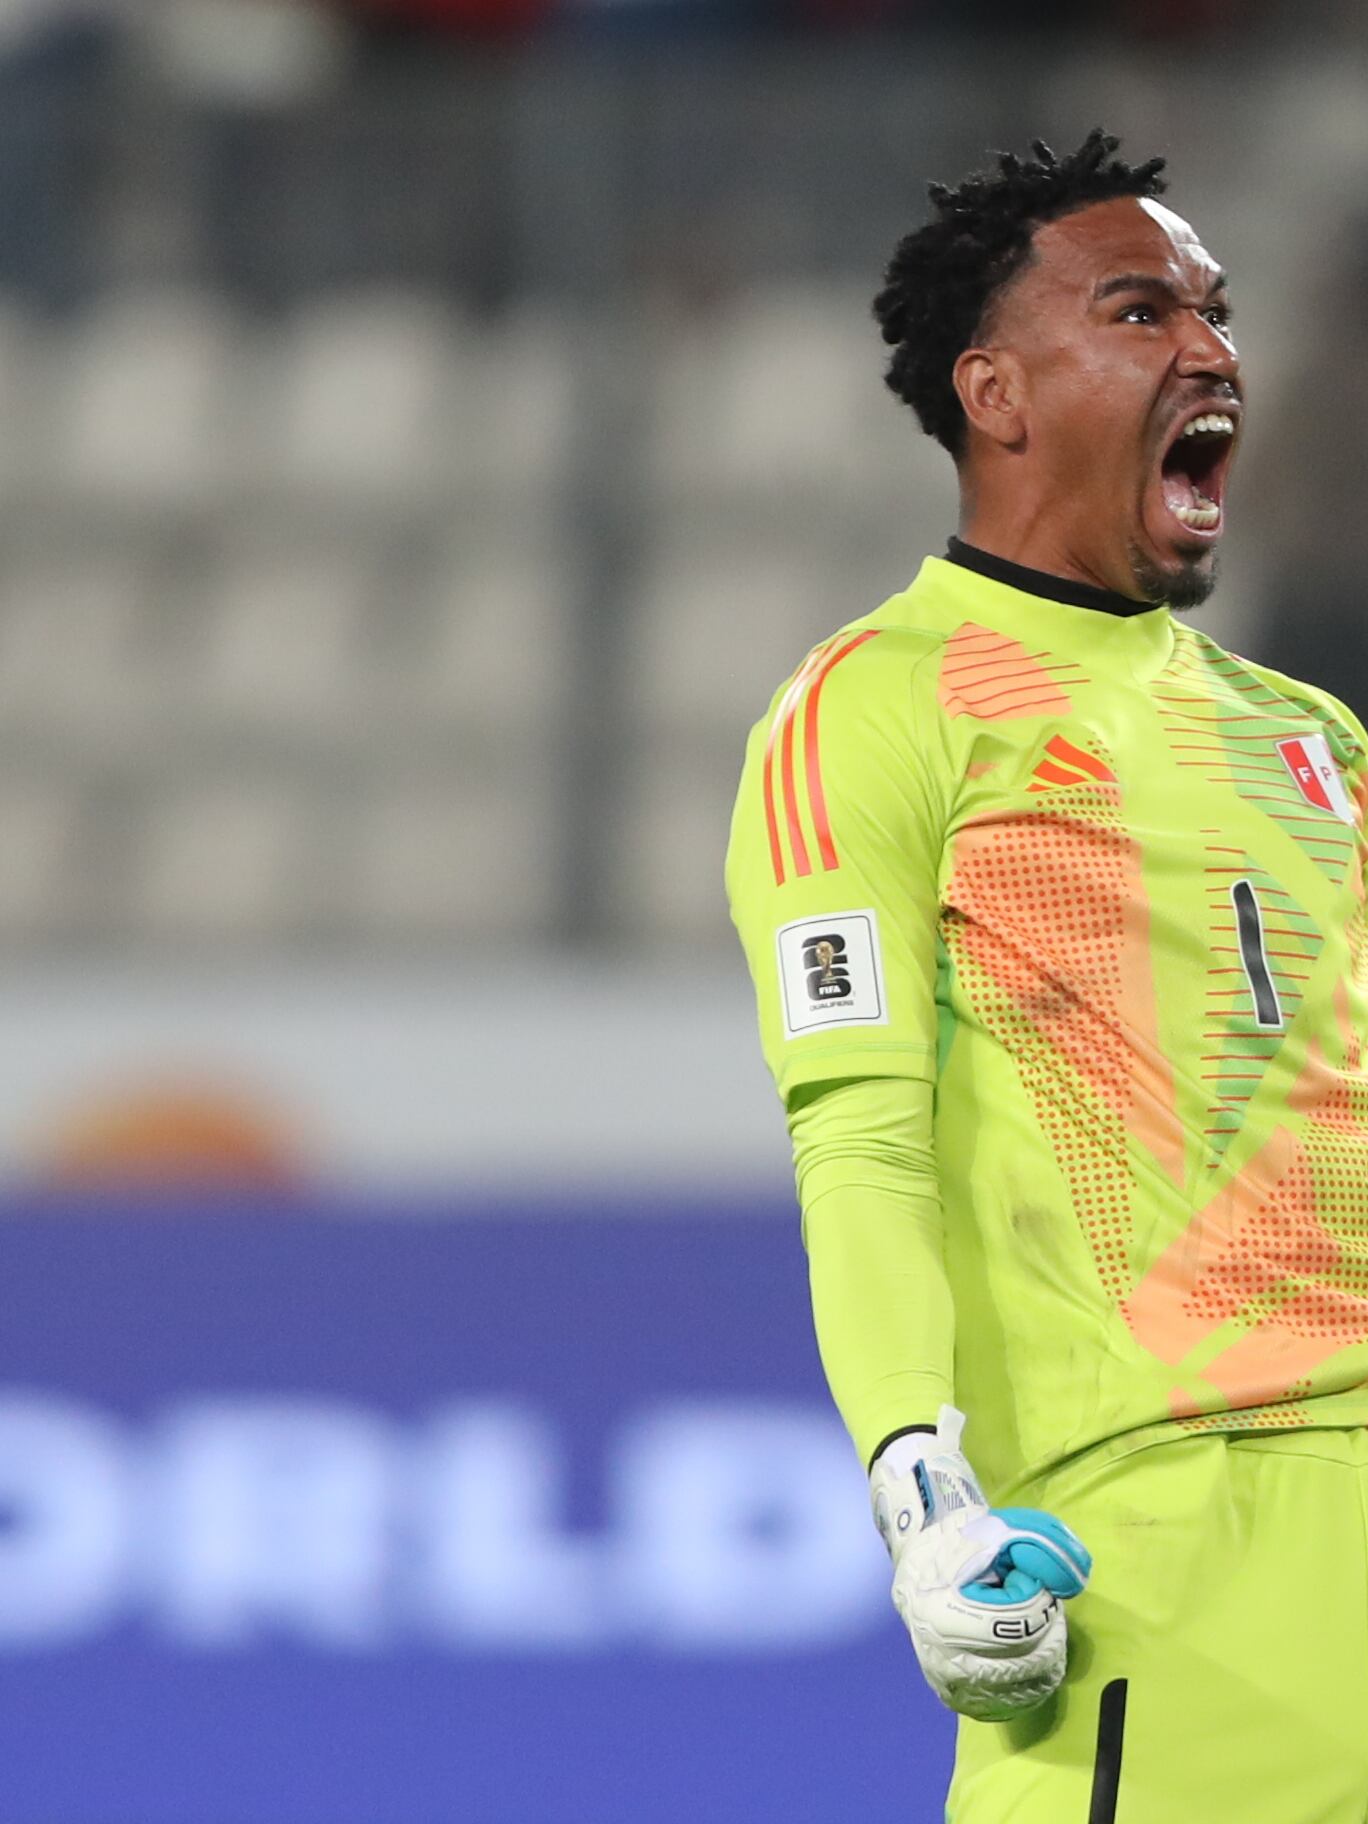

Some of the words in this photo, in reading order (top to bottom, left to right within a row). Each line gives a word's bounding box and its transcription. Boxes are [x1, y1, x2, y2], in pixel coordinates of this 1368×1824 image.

[1230, 879, 1283, 1029] 1
[818, 984, 842, 995] FIFA
[993, 1597, 1058, 1639] ELIT
